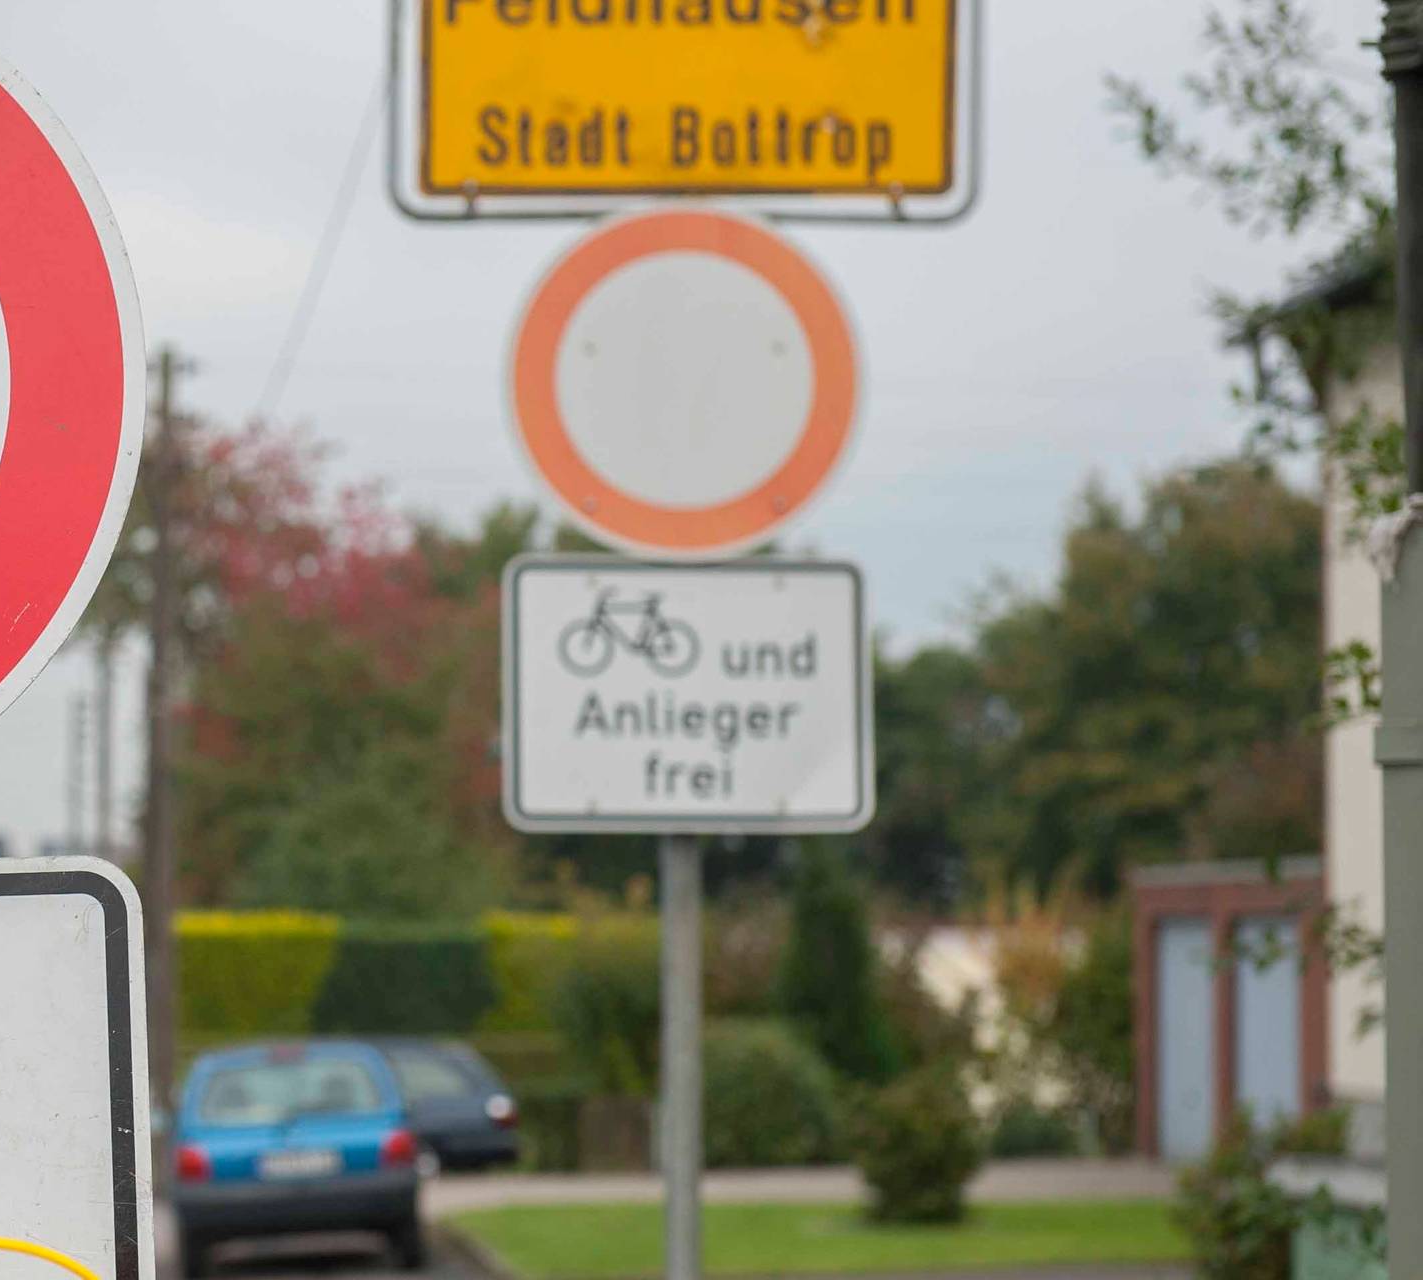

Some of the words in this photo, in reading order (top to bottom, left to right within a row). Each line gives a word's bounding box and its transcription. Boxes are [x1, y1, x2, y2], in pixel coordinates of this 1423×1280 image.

[477, 107, 632, 168] Stadt
[672, 106, 894, 180] Bottrop
[722, 633, 817, 678] und
[576, 691, 799, 750] Anlieger
[644, 753, 733, 797] frei
